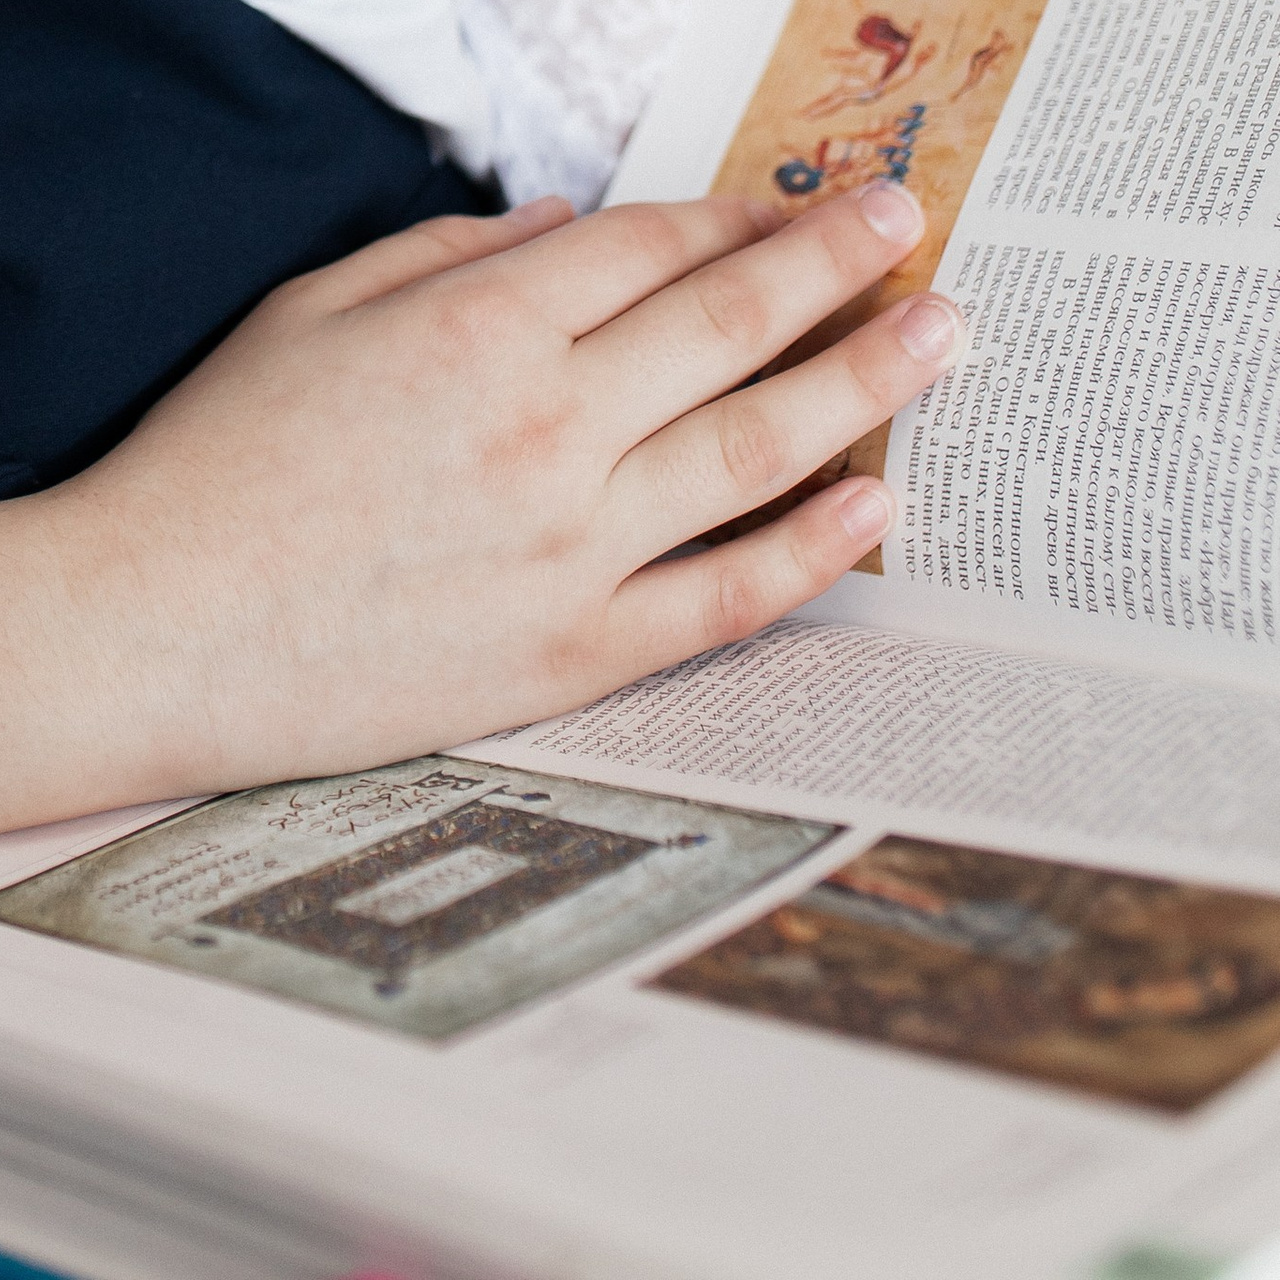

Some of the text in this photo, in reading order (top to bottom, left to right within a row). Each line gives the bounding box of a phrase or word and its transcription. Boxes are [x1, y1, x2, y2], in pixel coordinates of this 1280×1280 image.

[1245, 10, 1275, 57] более
[1208, 71, 1230, 102] или
[1230, 57, 1273, 139] традиции.
[1232, 61, 1252, 87] ста
[1219, 93, 1239, 119] лет
[1113, 115, 1160, 200] буквально
[1158, 97, 1204, 181] Сюжетная
[1163, 108, 1215, 222] орнаменталь-
[1091, 141, 1129, 218] монасты-
[1127, 137, 1166, 220] существо-
[1178, 124, 1227, 224] создавались
[1196, 166, 1229, 225] центре
[1213, 123, 1265, 227] развитие ху-
[1237, 168, 1266, 228] иконо-
[1145, 190, 1164, 221] жи-
[969, 245, 998, 296] имеет
[970, 245, 1015, 350] полководца
[990, 246, 1032, 343] рирующая
[1137, 256, 1156, 286] лю.
[1144, 259, 1174, 324] понято
[1021, 250, 1067, 361] изготовляли
[1051, 298, 1068, 320] то
[1033, 328, 1059, 384] время
[1035, 252, 1102, 465] зантийской живописи.
[1128, 347, 1147, 379] как
[950, 363, 979, 431] Иисуса
[957, 356, 999, 480] библейскую
[973, 249, 1049, 594] тичной поры. Одна из них, иллюст-
[1005, 367, 1029, 426] копии
[1084, 308, 1140, 532] послеиконоборческий
[1110, 385, 1137, 463] возврат
[906, 425, 926, 493] вышли
[1042, 254, 1120, 607] оживил начавшее увядать древо ви-
[1065, 256, 1138, 611] неиссякаемый источник античности
[1122, 261, 1193, 621] новление былого великолепия было
[1141, 262, 1211, 625] восстановили». Вероятно, это восста-
[1157, 264, 1230, 627] низвергли, благочестивые правители
[1179, 265, 1249, 631] жения, которые обманщики здесь
[1197, 266, 1268, 634] пись над мозаикой гласила: «Изобра-
[925, 453, 939, 478] не
[937, 445, 961, 524] Навина,
[1217, 328, 1270, 638] подражает оно природе». Над-
[1242, 467, 1262, 521] было
[905, 505, 916, 527] из
[992, 448, 1011, 557] рукописей
[1010, 414, 1039, 600] Константинополе
[1098, 485, 1121, 567] былому
[1259, 466, 1280, 574] искусство
[900, 538, 917, 582] упо-
[922, 483, 935, 584] книги-ко-
[937, 536, 952, 587] даже
[952, 494, 970, 591] историю
[992, 564, 1004, 597] ан-
[1079, 537, 1098, 614] период
[1103, 573, 1116, 617] сти-
[1242, 610, 1256, 642] так
[1261, 580, 1275, 644] живо-
[757, 667, 777, 682] за
[771, 660, 825, 703] девушка
[775, 642, 815, 669] стоит
[837, 666, 858, 682] на
[576, 678, 647, 734] утренний
[616, 679, 667, 718] просто
[632, 678, 705, 737] маленький
[636, 681, 684, 718] Эроса
[674, 681, 720, 718] имеют
[699, 685, 734, 714] ночи
[708, 680, 759, 724] спиной
[724, 662, 803, 725] опущенным
[744, 697, 798, 742] пророк
[792, 680, 840, 719] второй
[806, 665, 883, 724] миниатюре
[529, 714, 583, 750] прогна-
[539, 733, 575, 753] час,
[558, 716, 618, 757] молится
[578, 725, 624, 757] утрен-
[611, 717, 676, 763] голубова-
[635, 711, 702, 760] (поэтому
[676, 711, 761, 776] покрывалом
